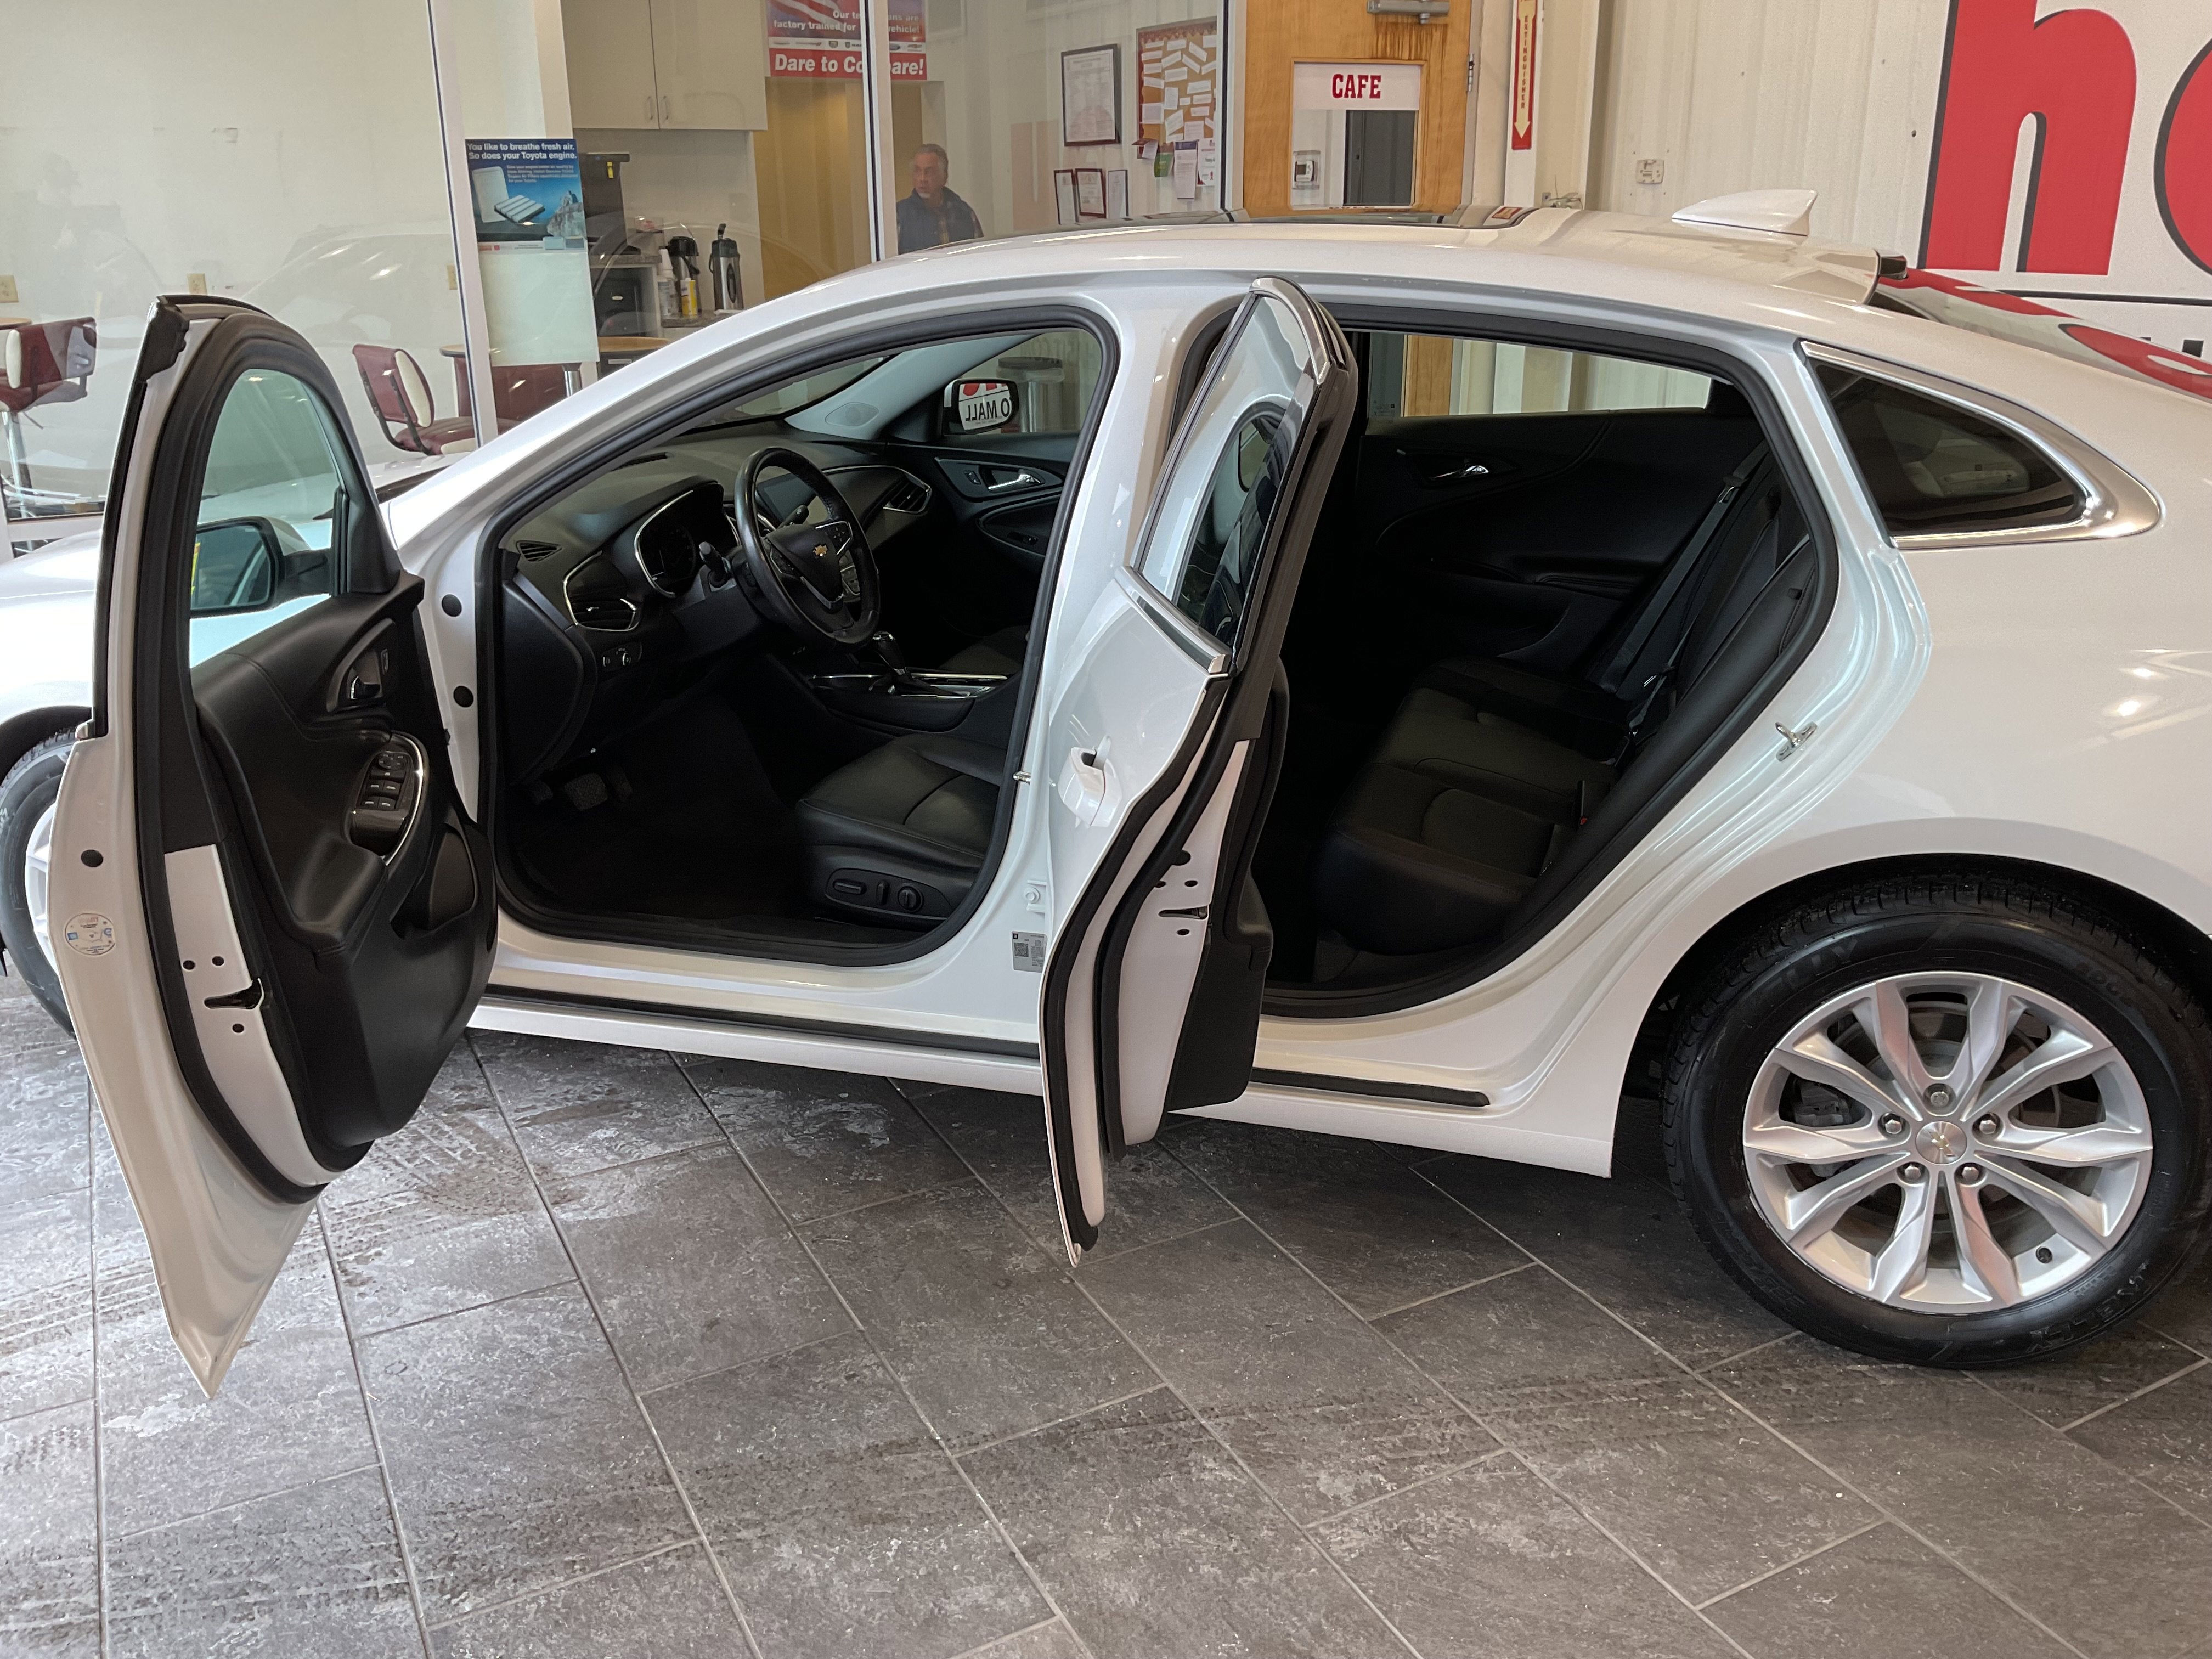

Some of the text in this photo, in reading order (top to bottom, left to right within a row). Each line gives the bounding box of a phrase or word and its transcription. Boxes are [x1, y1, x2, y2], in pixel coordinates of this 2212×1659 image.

[774, 20, 806, 30] factory
[843, 22, 856, 31] for
[775, 54, 924, 75] Dare to Coare!
[1331, 74, 1381, 99] CAFE
[521, 152, 547, 160] Toyota
[549, 152, 577, 160] engine.
